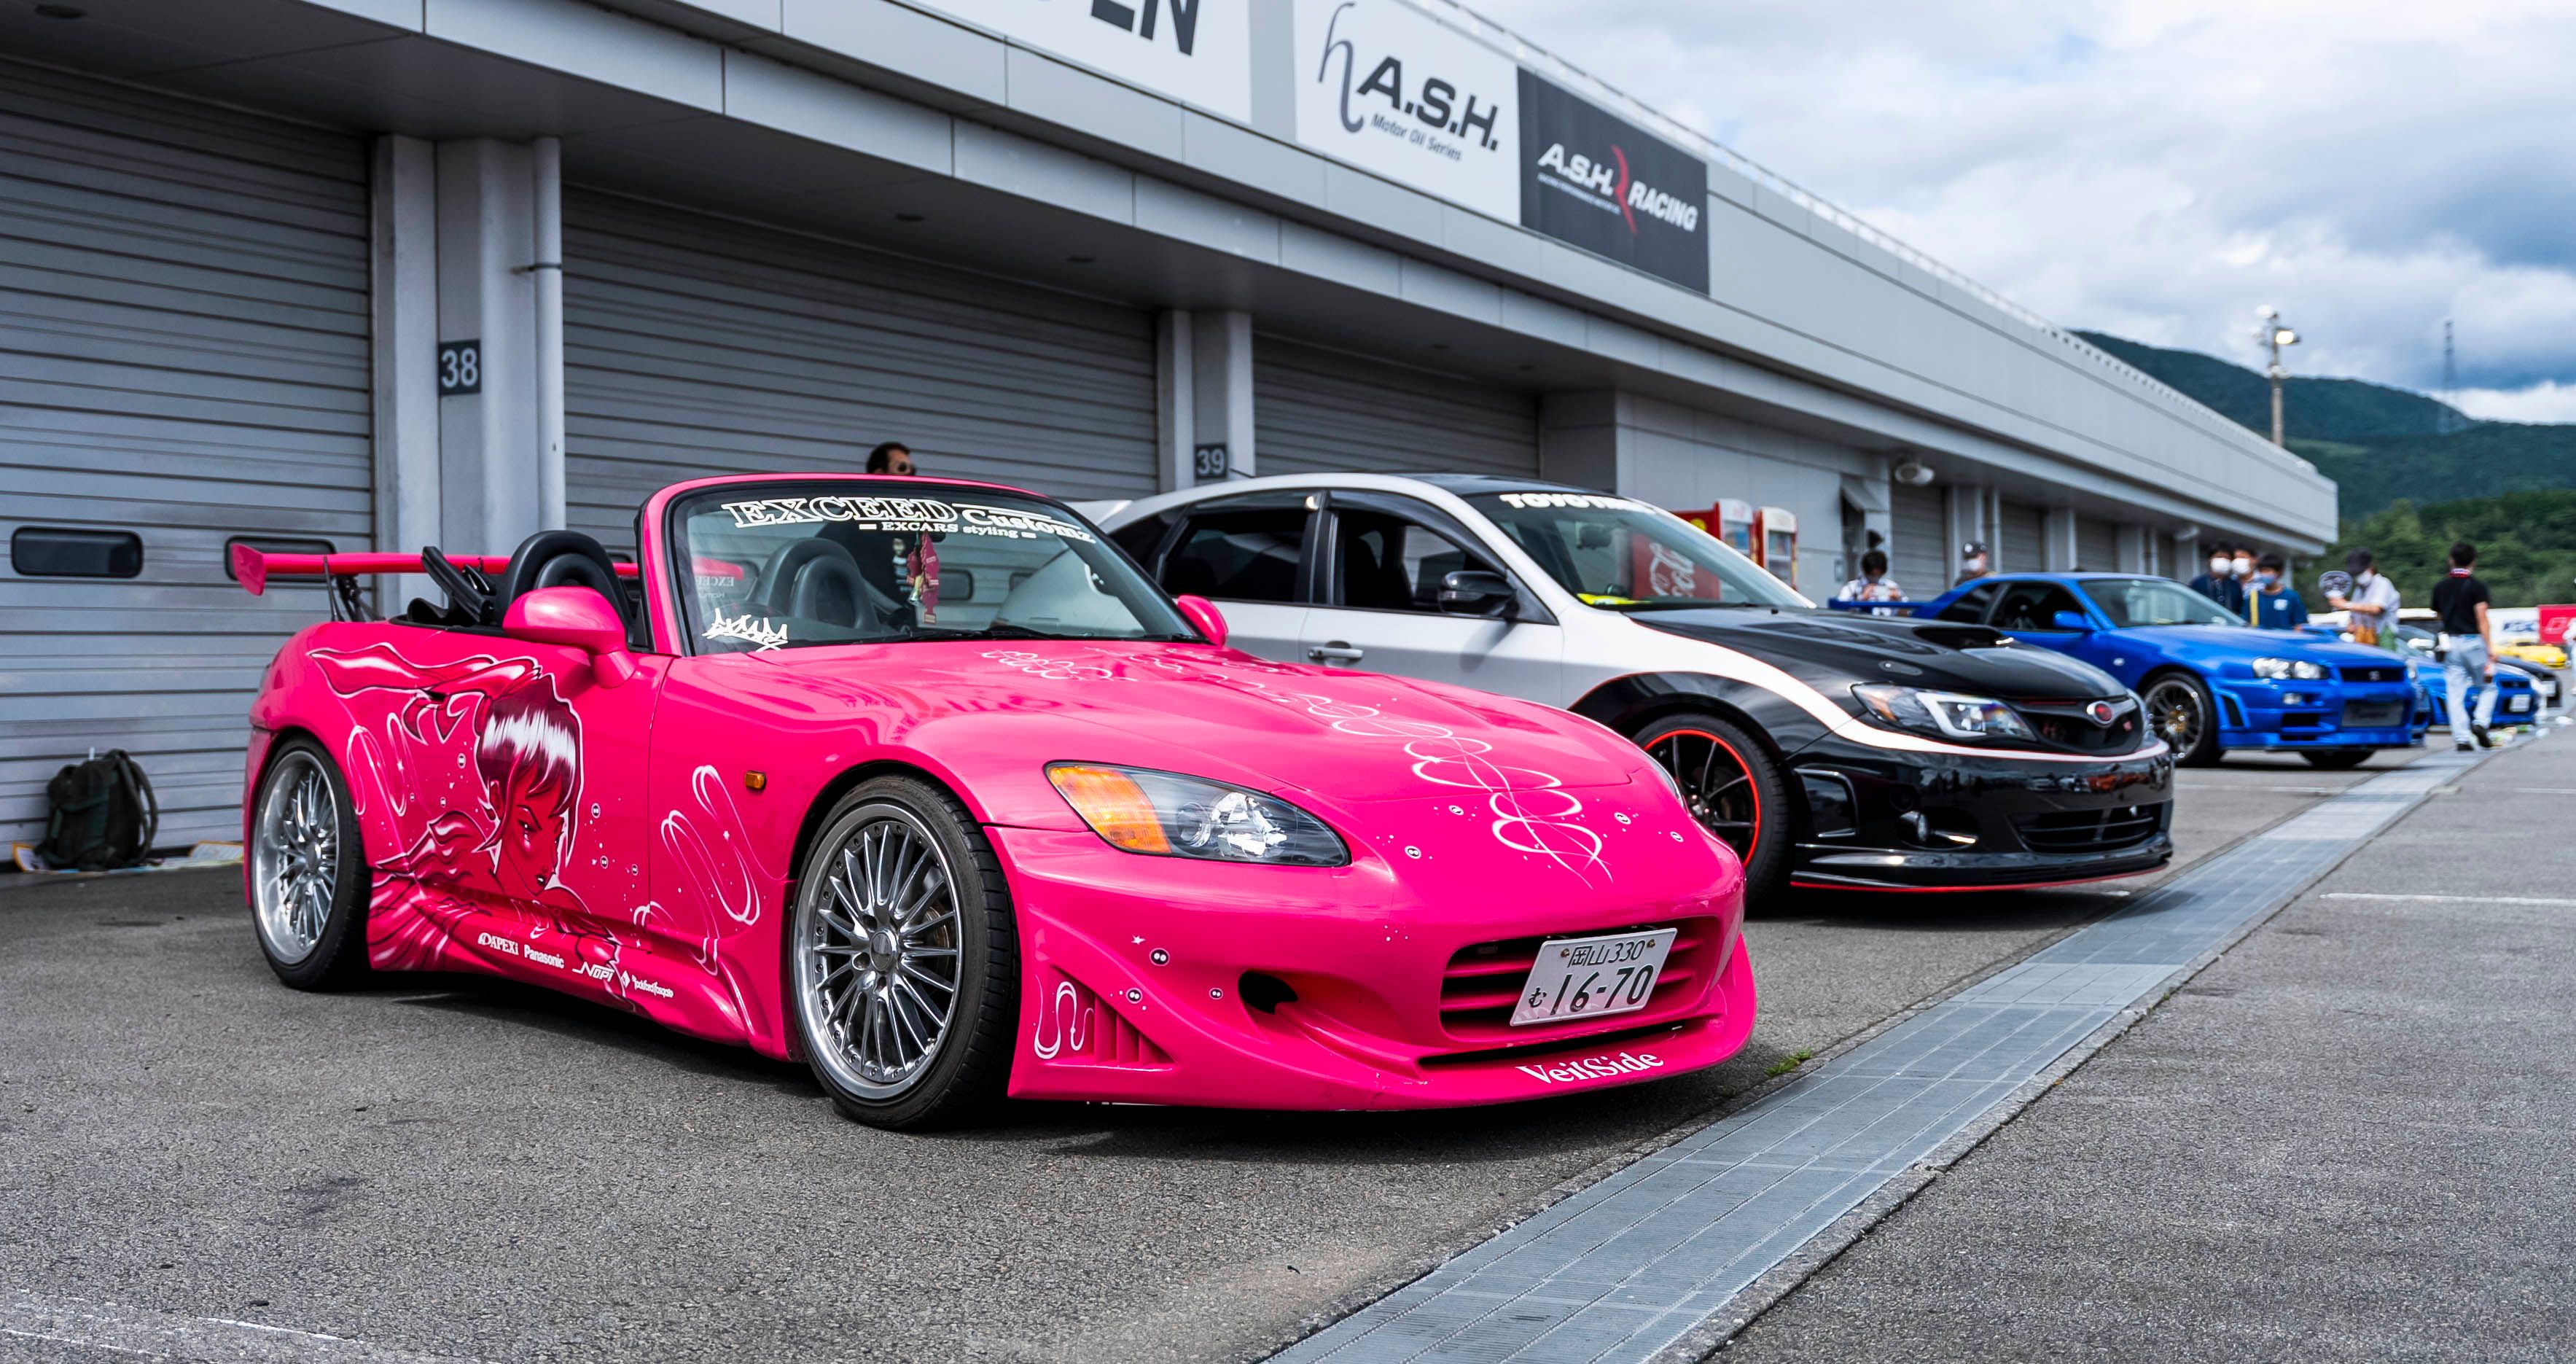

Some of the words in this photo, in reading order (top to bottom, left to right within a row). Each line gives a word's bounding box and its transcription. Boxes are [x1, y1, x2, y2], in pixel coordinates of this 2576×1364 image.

[1370, 113, 1408, 138] Motor
[1409, 128, 1426, 146] Oil
[1627, 180, 1698, 233] RACING
[441, 348, 478, 389] 38
[1197, 448, 1225, 475] 39
[721, 496, 958, 528] EXCEED
[882, 522, 959, 533] EXCARS
[962, 524, 1018, 539] styling
[524, 944, 564, 969] Panasonic
[1529, 987, 1547, 1008] む
[1550, 964, 1654, 1016] 16-70
[1515, 1052, 1664, 1085] VeilSide
